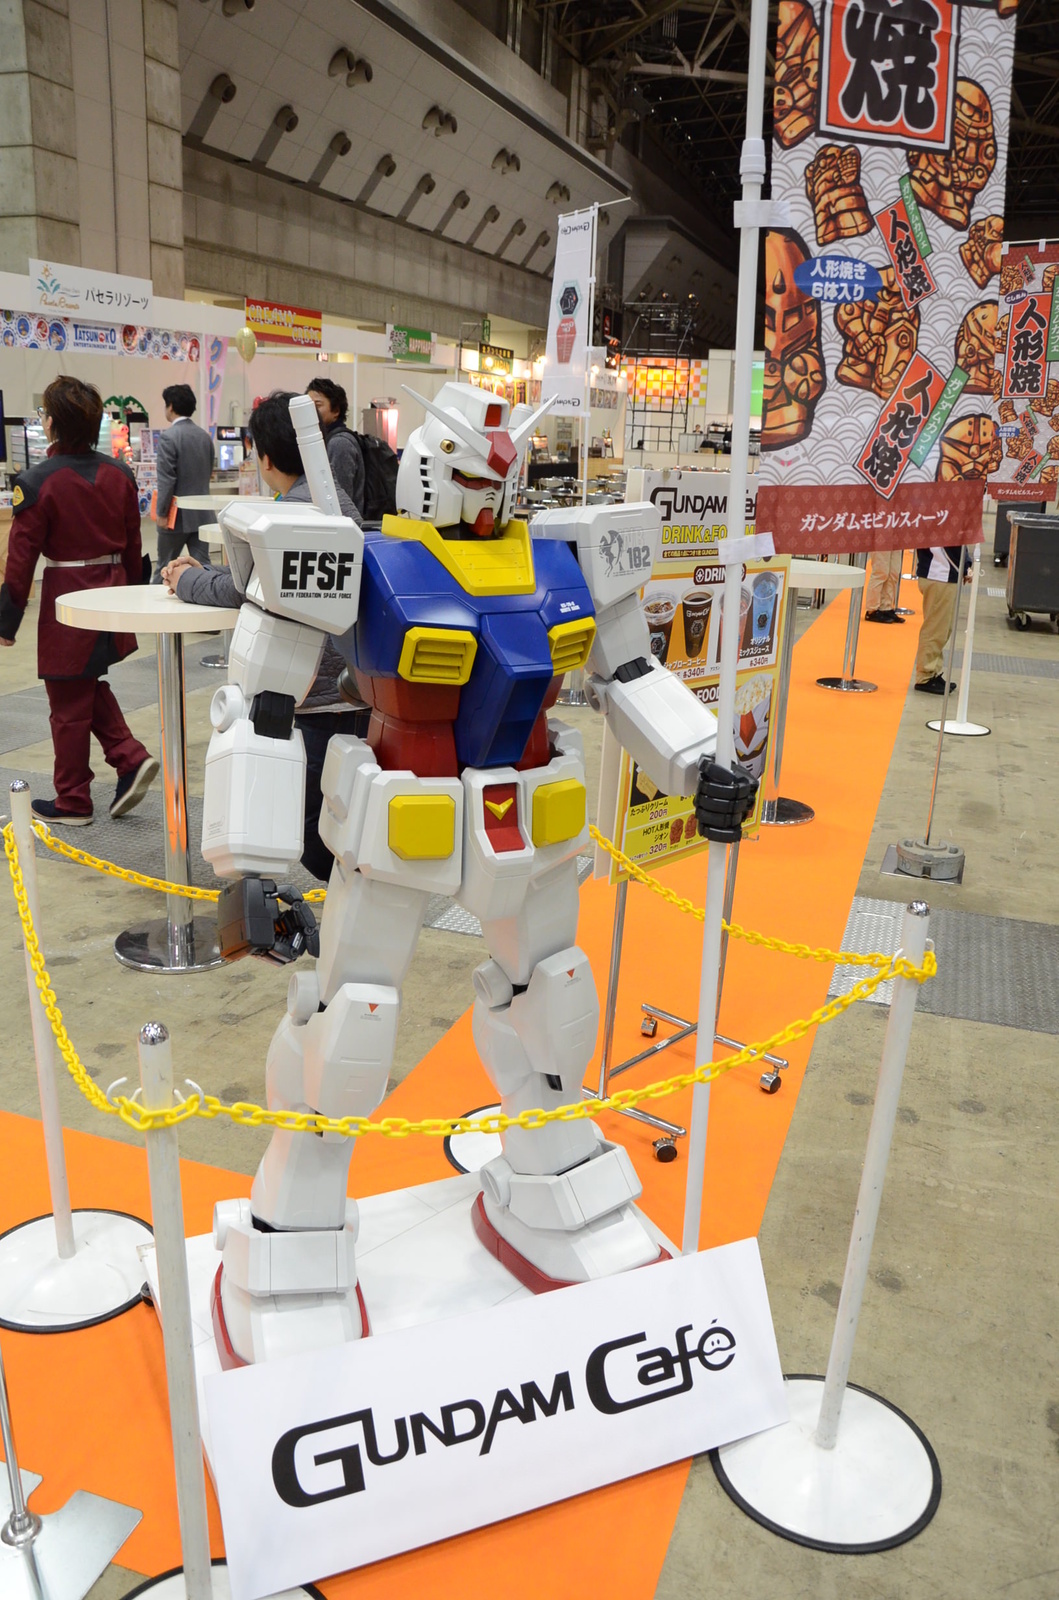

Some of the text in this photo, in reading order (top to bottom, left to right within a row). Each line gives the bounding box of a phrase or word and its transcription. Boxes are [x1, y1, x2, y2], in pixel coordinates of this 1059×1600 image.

[889, 208, 932, 303] 人形焼
[810, 259, 867, 280] 人形焼き
[85, 287, 149, 310] パセラリゾーツ
[811, 283, 865, 303] 6体入り
[1009, 298, 1047, 394] 人形焼
[915, 376, 963, 457] ガンダムカフェ
[863, 369, 934, 489] 人形焼
[650, 487, 728, 521] GUNDAM
[800, 509, 949, 532] ガンダムモビルスィーツ
[662, 524, 728, 544] DRINK&FO
[281, 551, 354, 590] EFSF
[705, 567, 726, 582] DRIN
[750, 635, 771, 645] オリジナル
[739, 647, 770, 657] ミックスジュース
[683, 667, 705, 679] 各340円
[697, 687, 720, 702] FOO
[649, 809, 668, 820] 200円
[649, 843, 668, 855] 320円
[271, 1318, 737, 1509] GUNDAM Café
